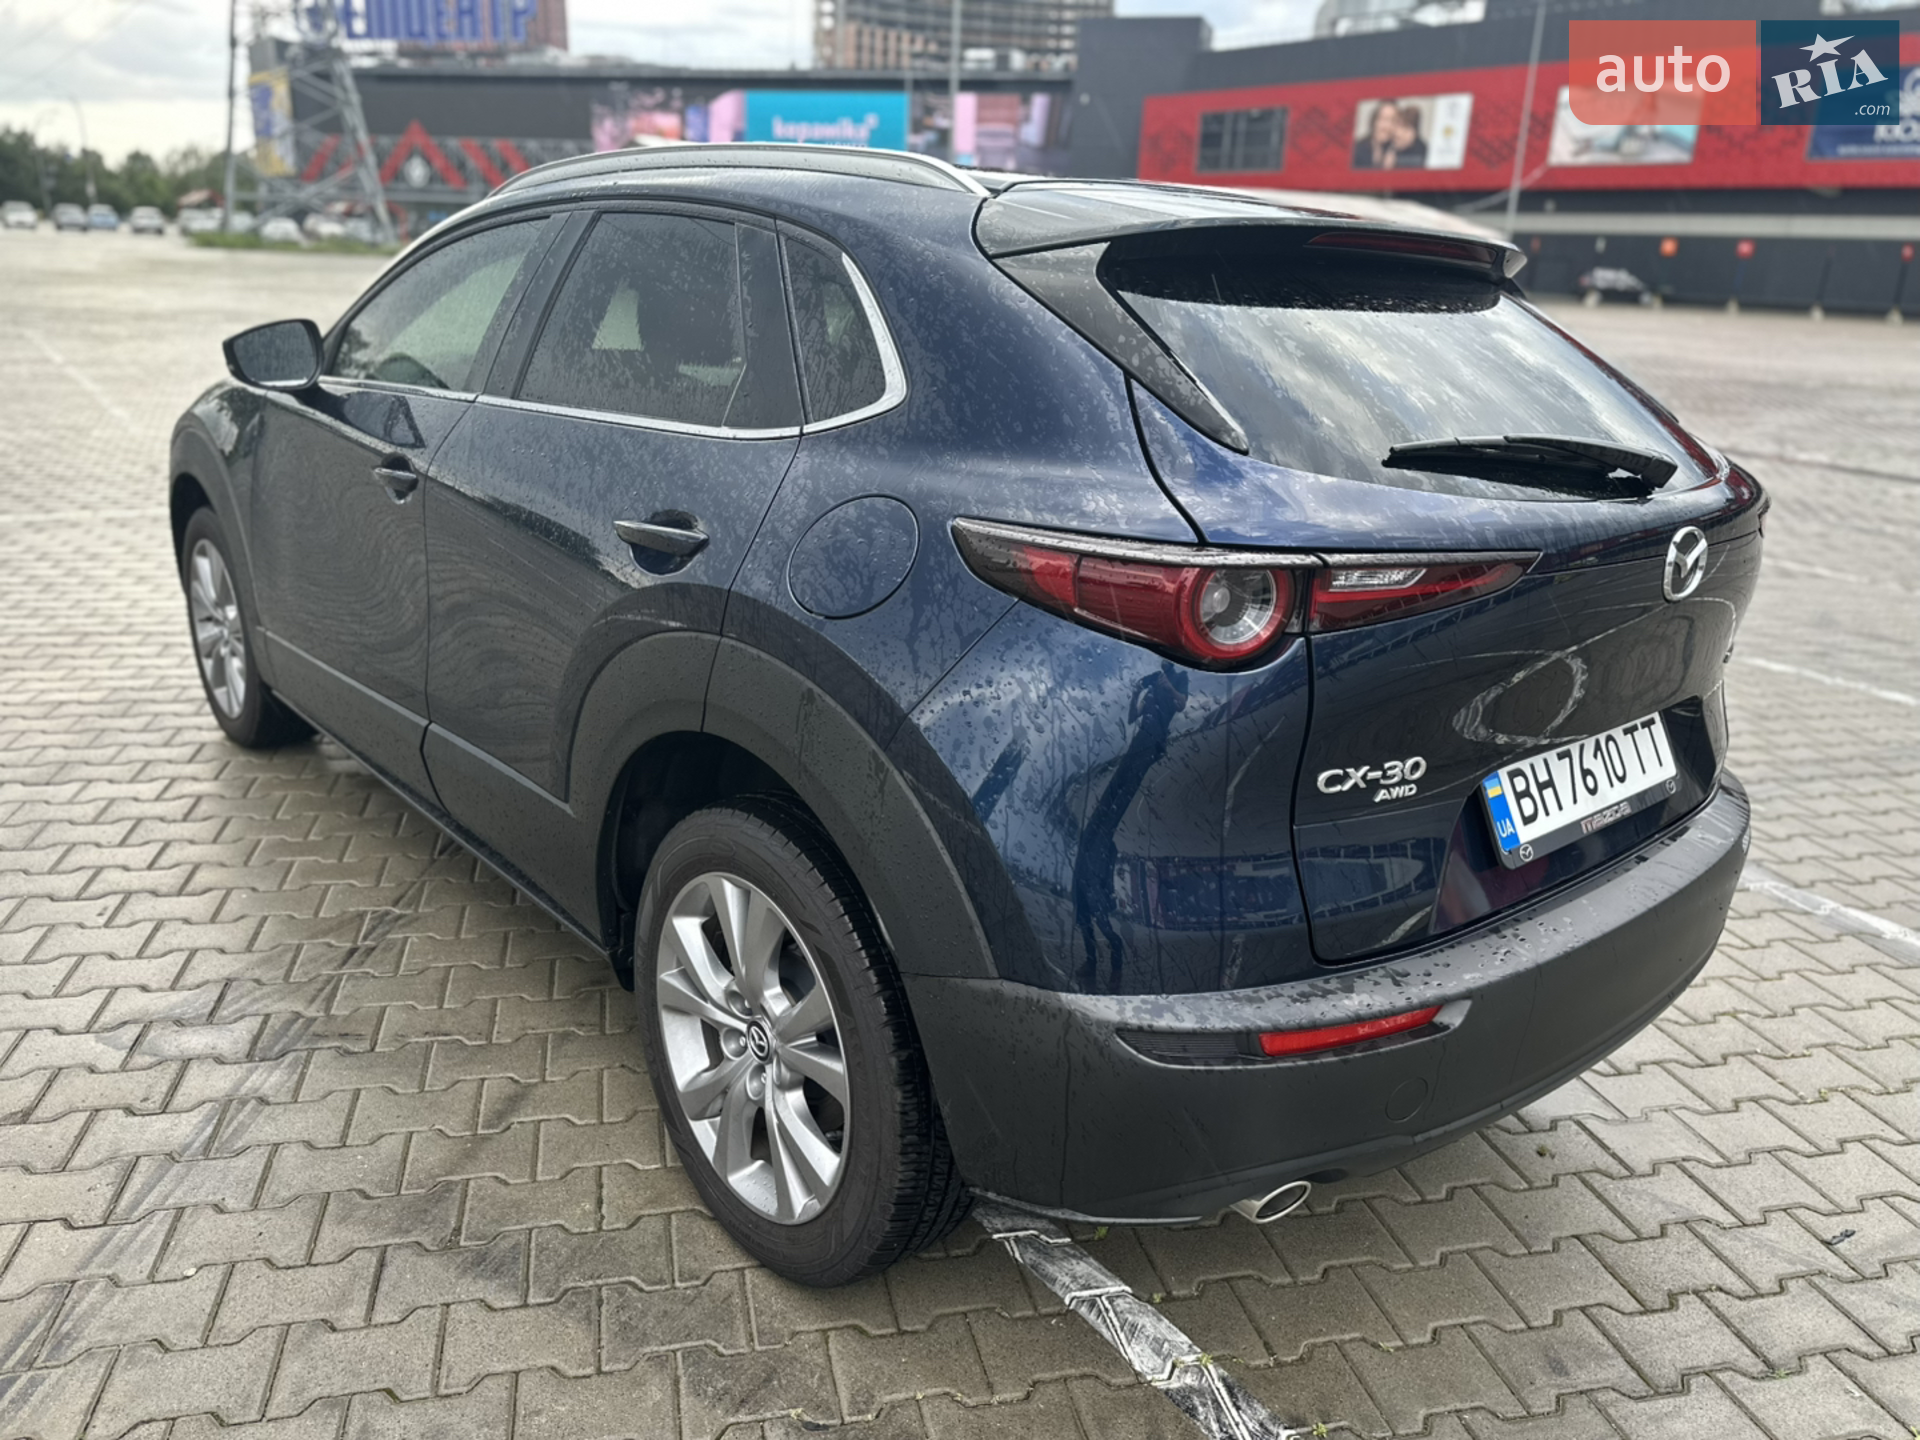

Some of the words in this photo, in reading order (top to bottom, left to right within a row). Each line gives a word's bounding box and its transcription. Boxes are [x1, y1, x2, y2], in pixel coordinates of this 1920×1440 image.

[1316, 756, 1427, 794] CX-30
[1506, 757, 1564, 827] BH
[1556, 733, 1627, 805] 7610
[1622, 717, 1664, 775] TT
[1373, 783, 1417, 803] AWD
[1497, 818, 1515, 838] UA
[1580, 801, 1632, 834] mazda
